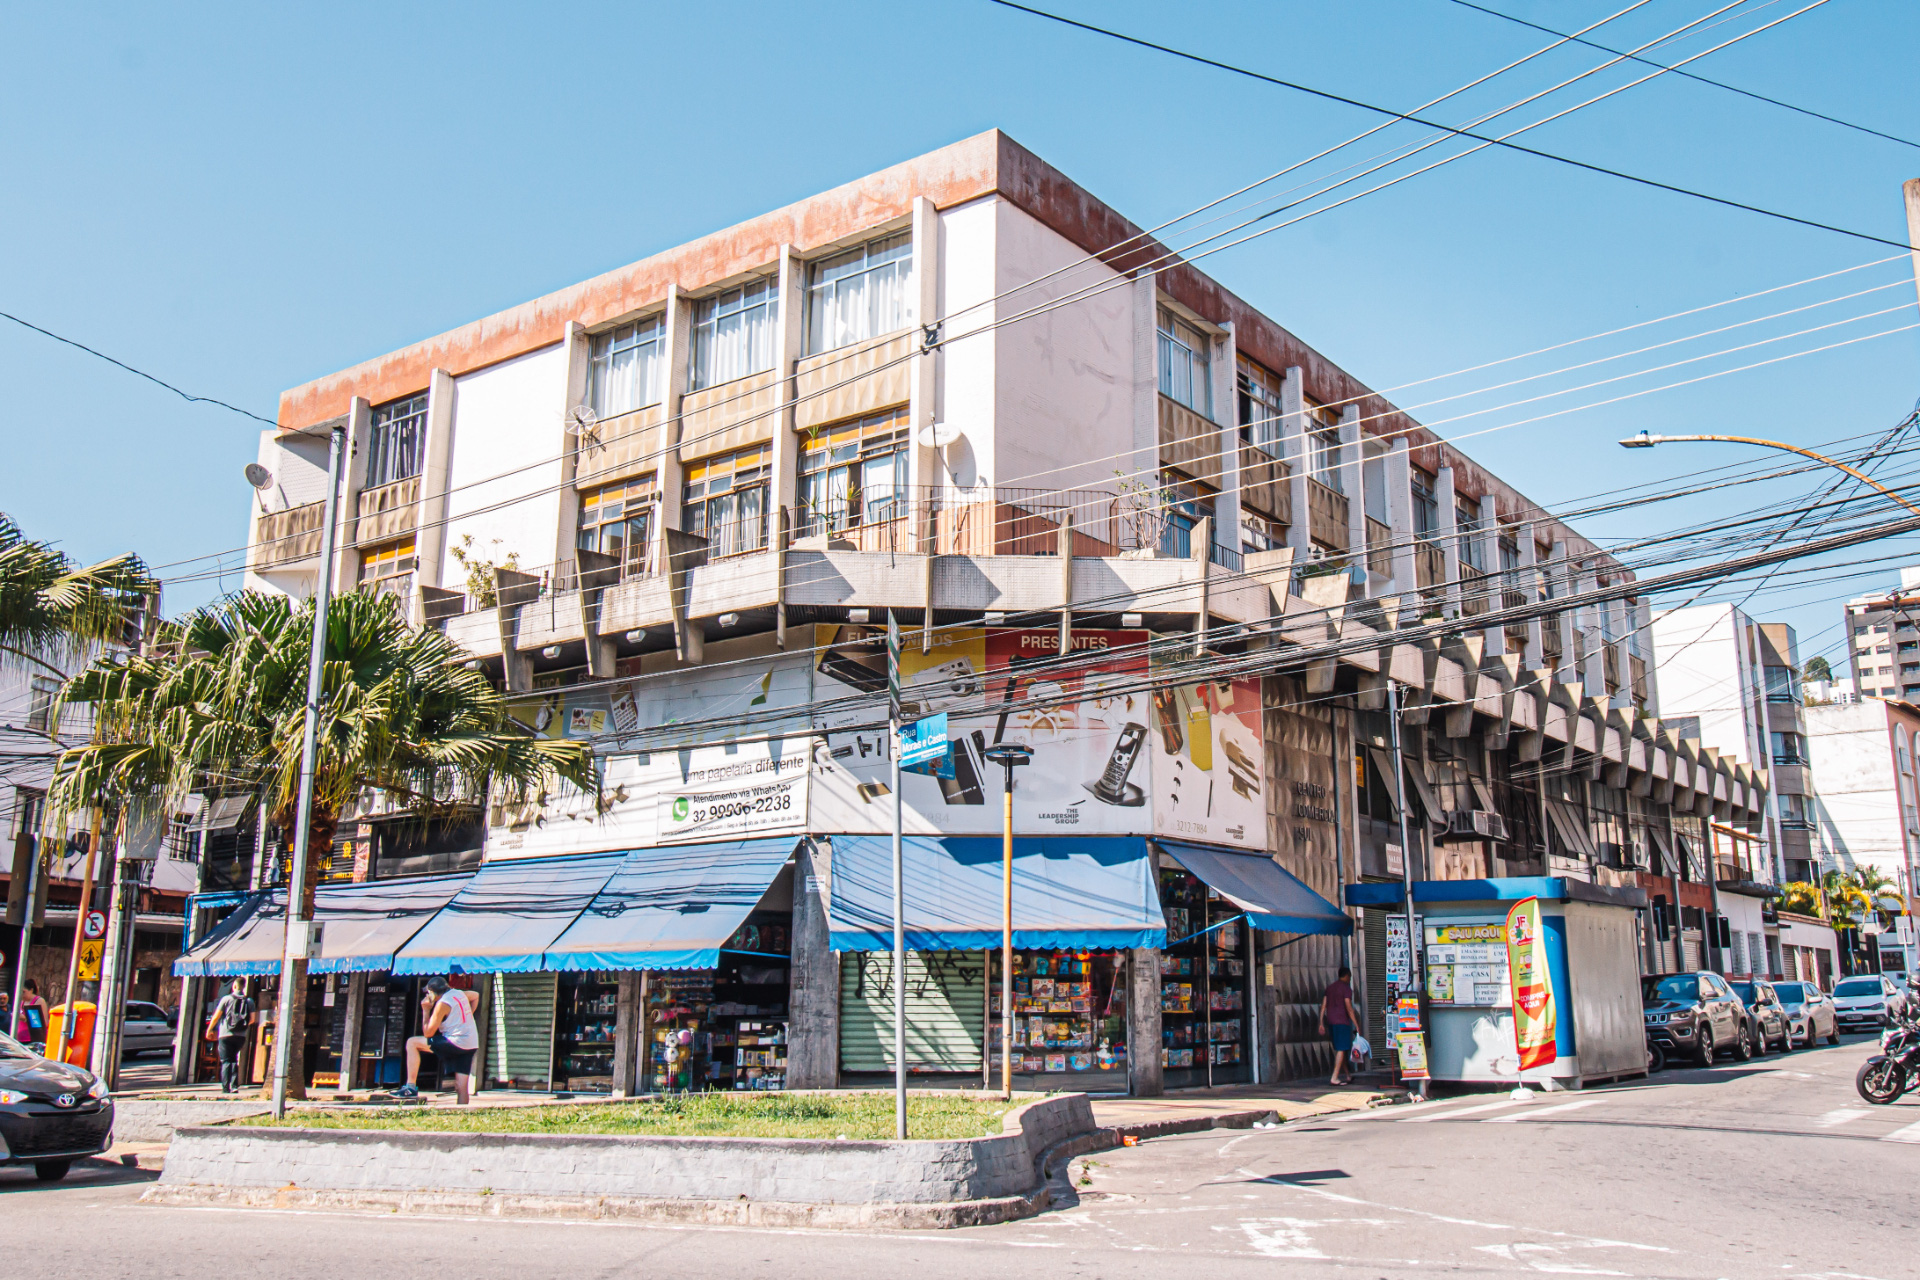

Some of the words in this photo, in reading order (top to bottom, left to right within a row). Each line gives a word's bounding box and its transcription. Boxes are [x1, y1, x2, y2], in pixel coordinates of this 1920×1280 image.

[1021, 635, 1108, 649] PRESNTES
[902, 729, 916, 739] Rua
[927, 733, 947, 746] Castro
[684, 770, 705, 782] uma
[755, 756, 804, 773] diferente
[693, 791, 738, 804] Atendimento
[739, 789, 751, 798] via
[693, 810, 706, 822] 32
[1448, 928, 1472, 941] SAIU
[1474, 927, 1500, 939] AQUI
[1471, 970, 1490, 978] CASA
[1520, 991, 1546, 1002] COMPRE
[1524, 1001, 1540, 1009] AQUI
